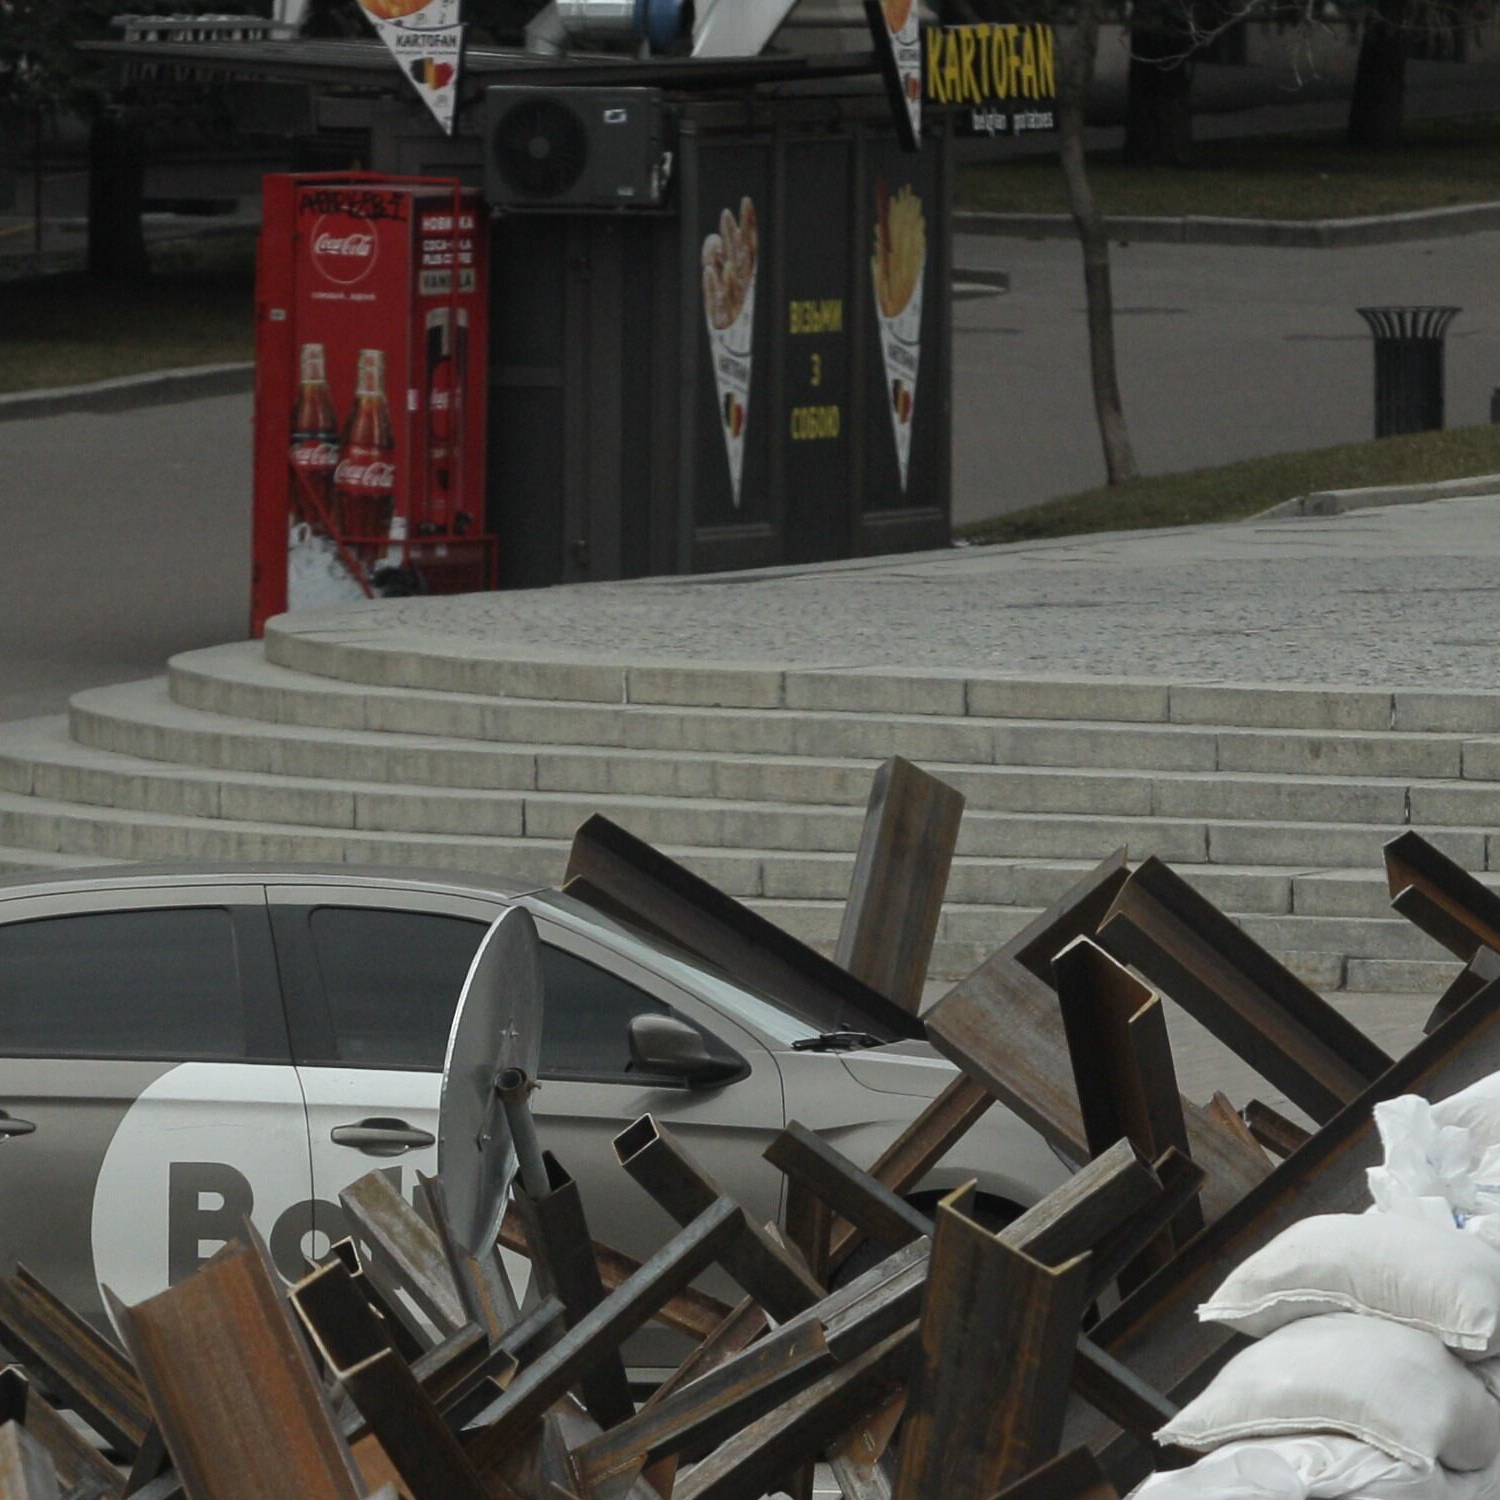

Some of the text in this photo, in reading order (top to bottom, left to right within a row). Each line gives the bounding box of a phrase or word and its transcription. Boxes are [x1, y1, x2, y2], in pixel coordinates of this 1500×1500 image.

[396, 34, 457, 48] KARTOFAN
[927, 23, 1056, 104] KARTOFAN
[422, 216, 474, 231] НОВИКА
[789, 300, 842, 334] ВІЗЬМИ
[791, 405, 840, 440] СОБОЮ
